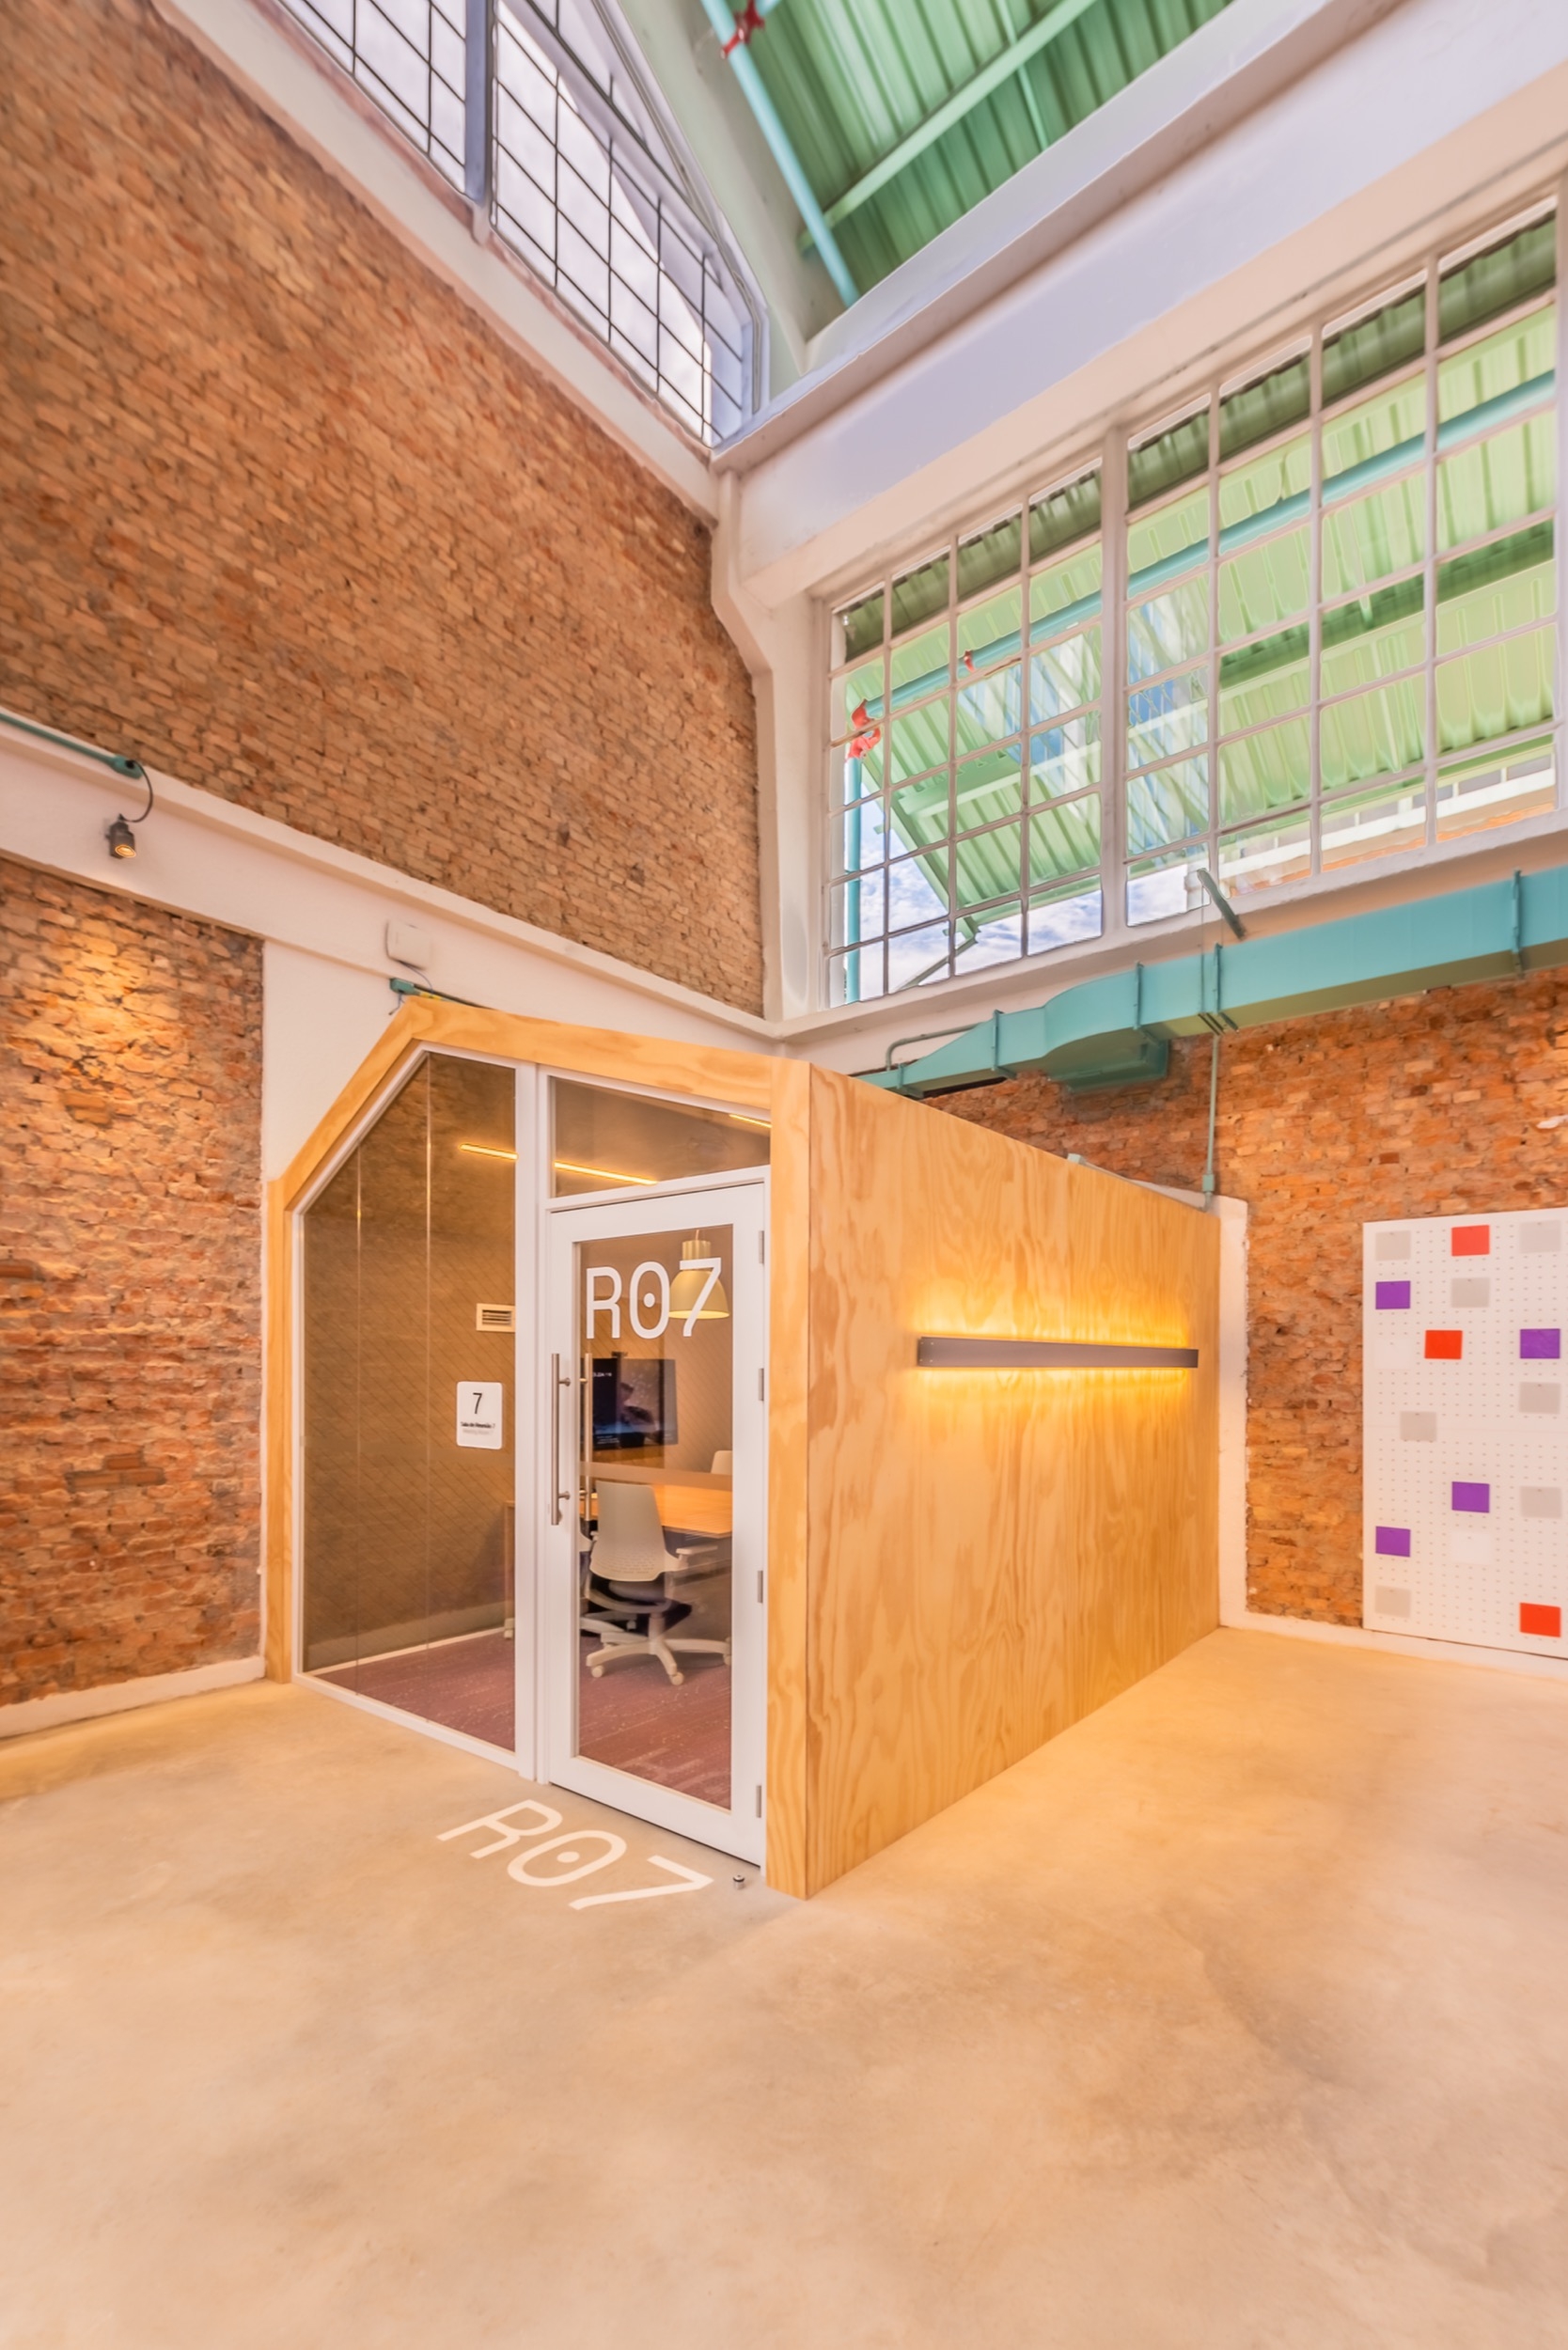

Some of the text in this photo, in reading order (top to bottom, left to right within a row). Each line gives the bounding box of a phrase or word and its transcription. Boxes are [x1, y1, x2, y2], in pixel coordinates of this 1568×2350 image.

[586, 1257, 722, 1340] R07
[472, 1392, 482, 1415] 7
[436, 1799, 714, 1911] R07
